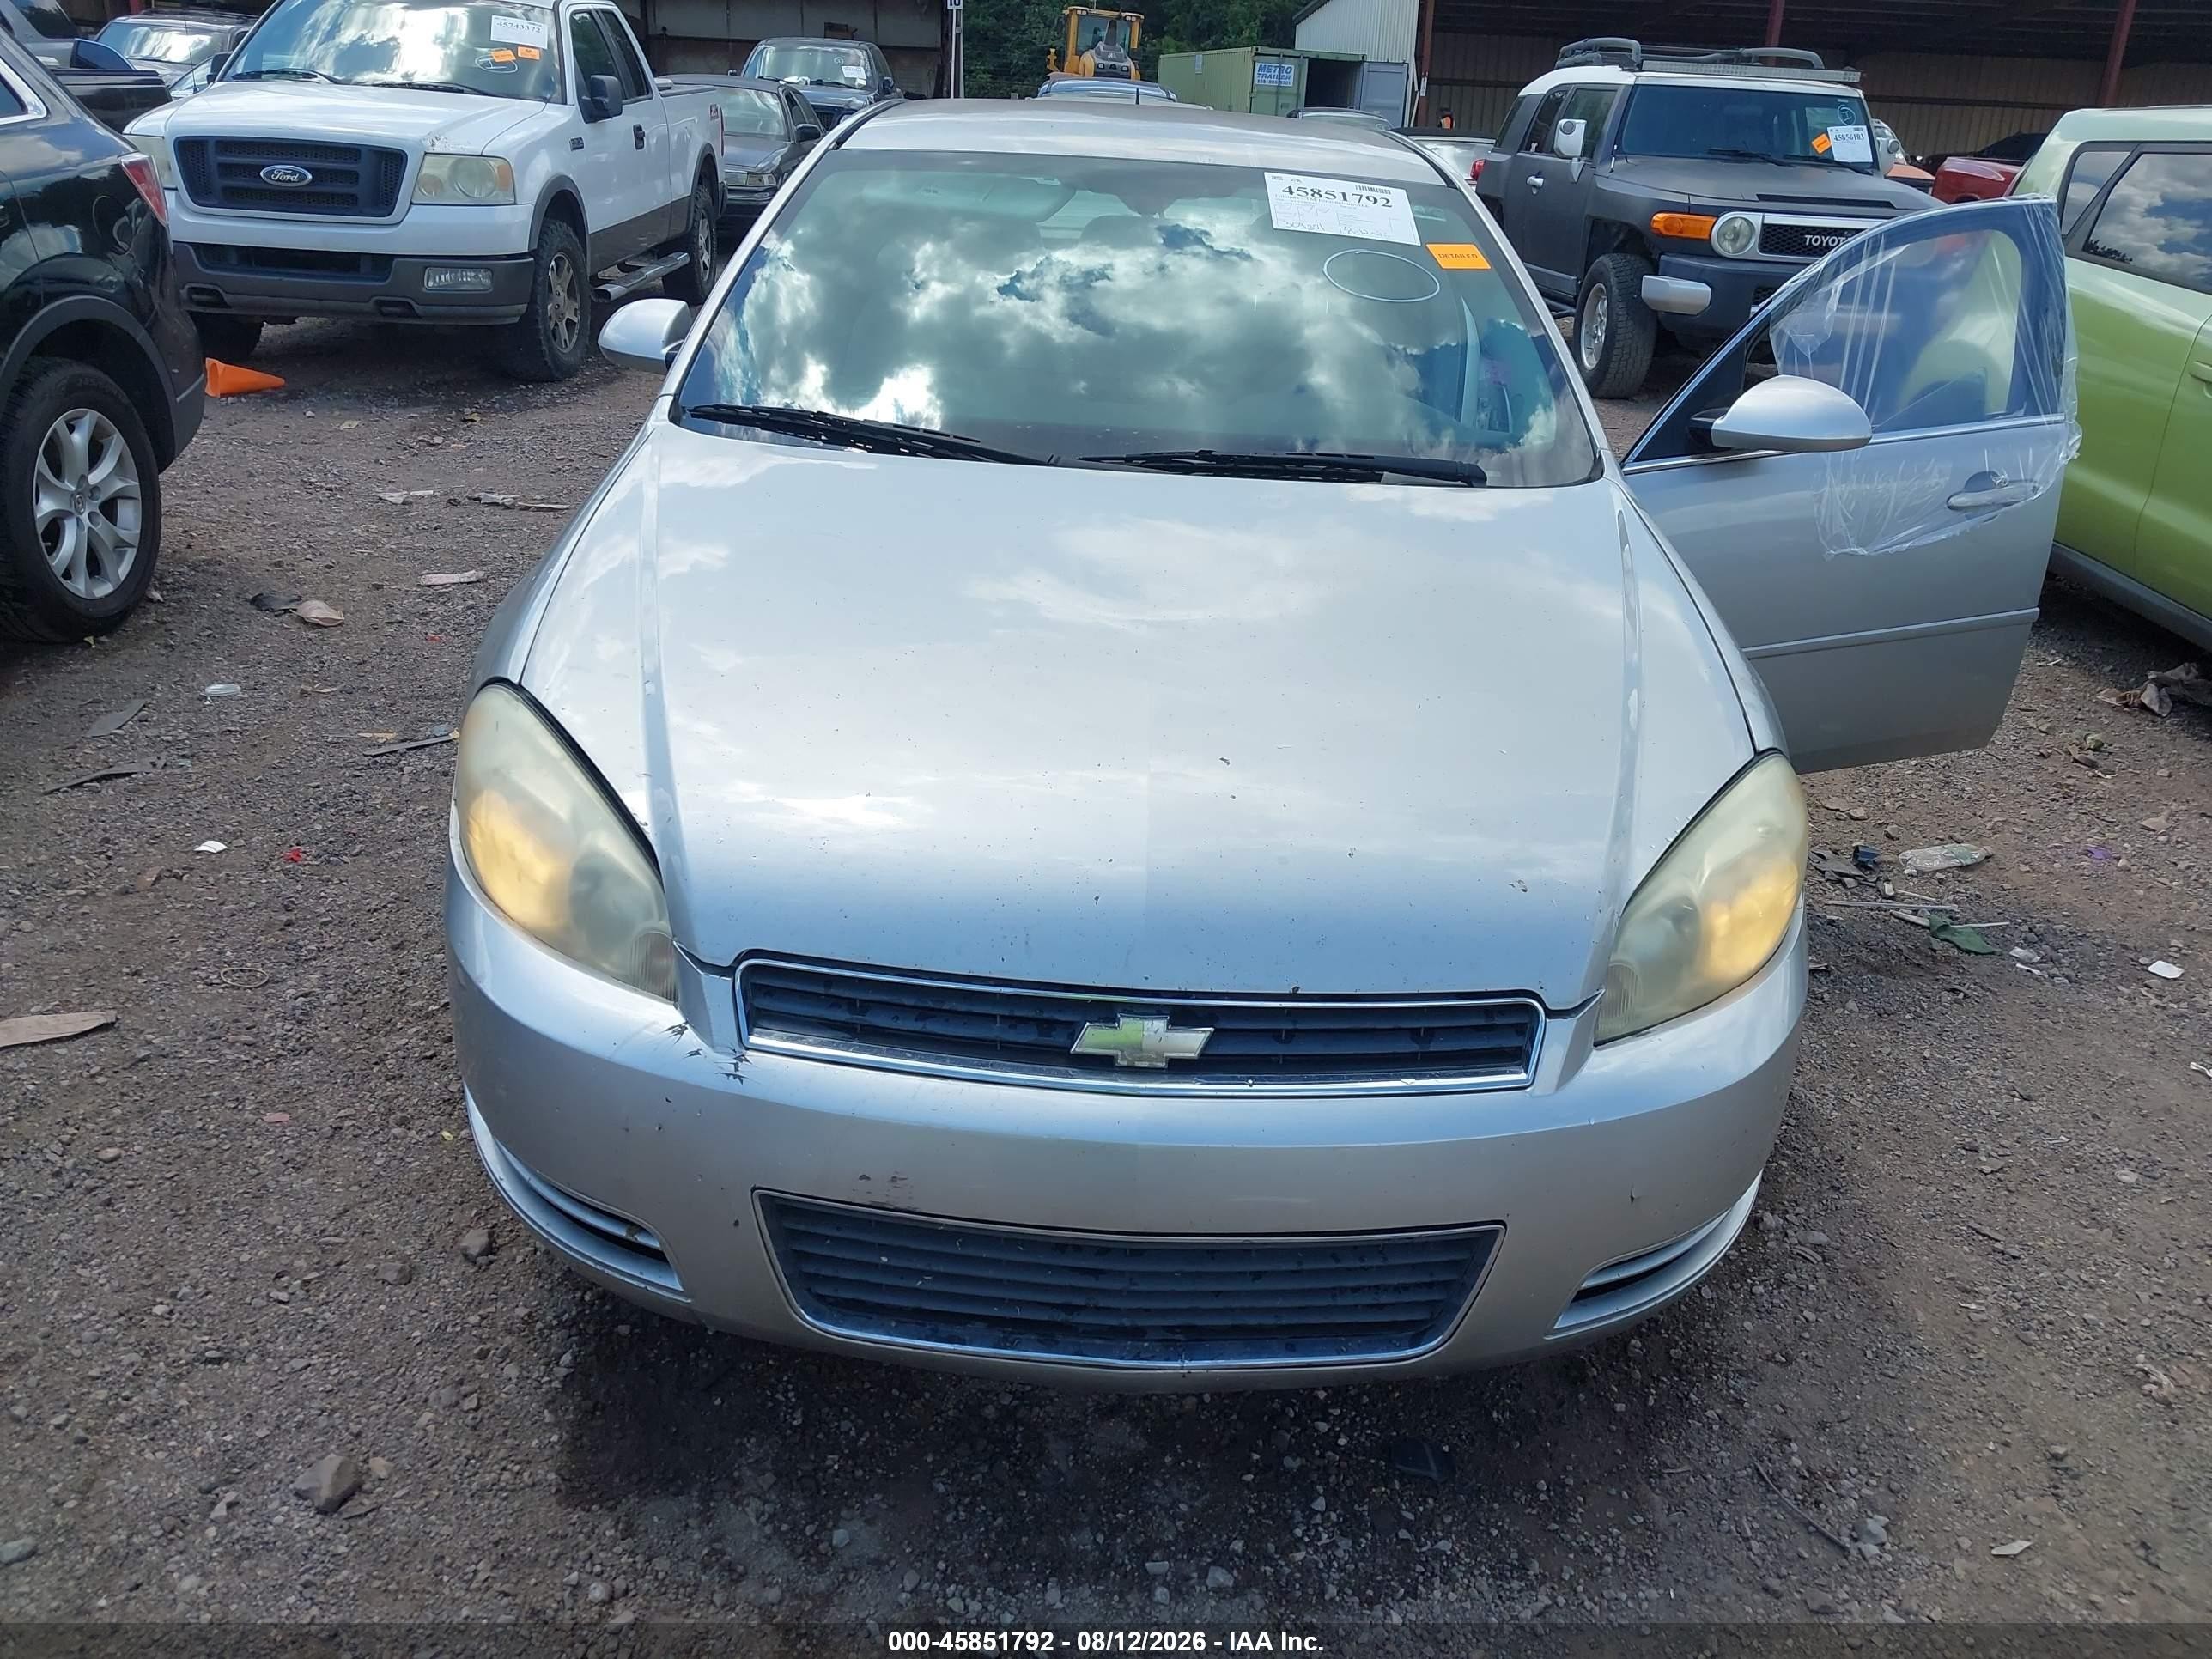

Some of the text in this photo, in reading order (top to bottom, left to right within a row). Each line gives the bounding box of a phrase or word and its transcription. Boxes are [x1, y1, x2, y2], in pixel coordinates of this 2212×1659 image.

[1258, 64, 1292, 74] METRO
[270, 168, 300, 182] Ford
[1281, 185, 1394, 209] 45851792
[1804, 234, 1846, 247] TOYOT
